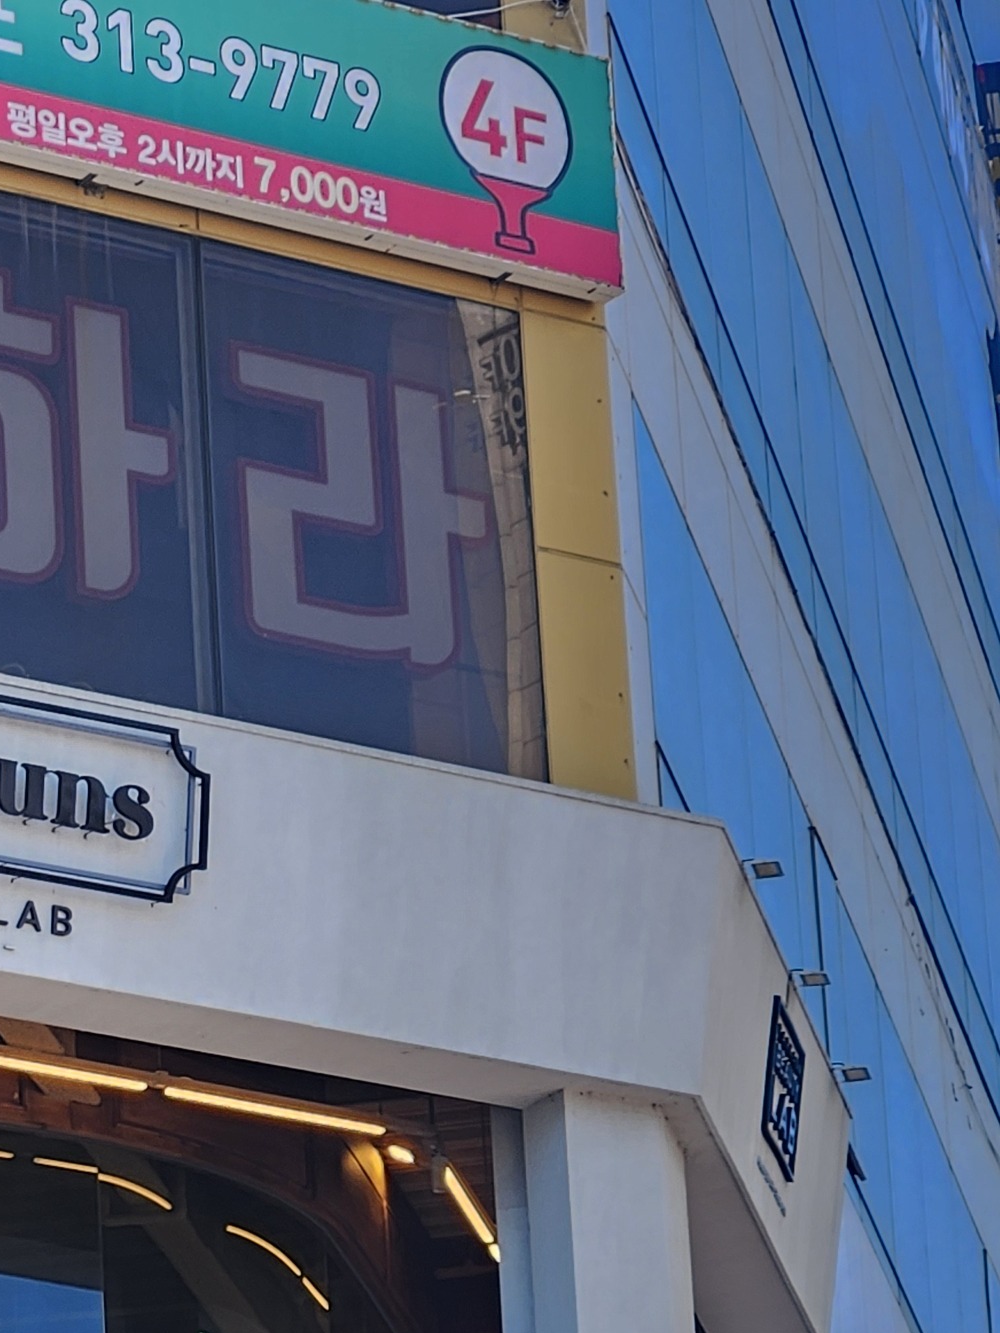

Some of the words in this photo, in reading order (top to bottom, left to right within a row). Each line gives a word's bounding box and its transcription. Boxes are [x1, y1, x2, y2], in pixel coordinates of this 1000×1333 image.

[60, 0, 381, 131] 313-9779
[460, 78, 548, 164] 4F
[6, 101, 127, 159] 평일오후
[136, 134, 245, 189] 2시까지
[252, 156, 388, 223] 7,000원
